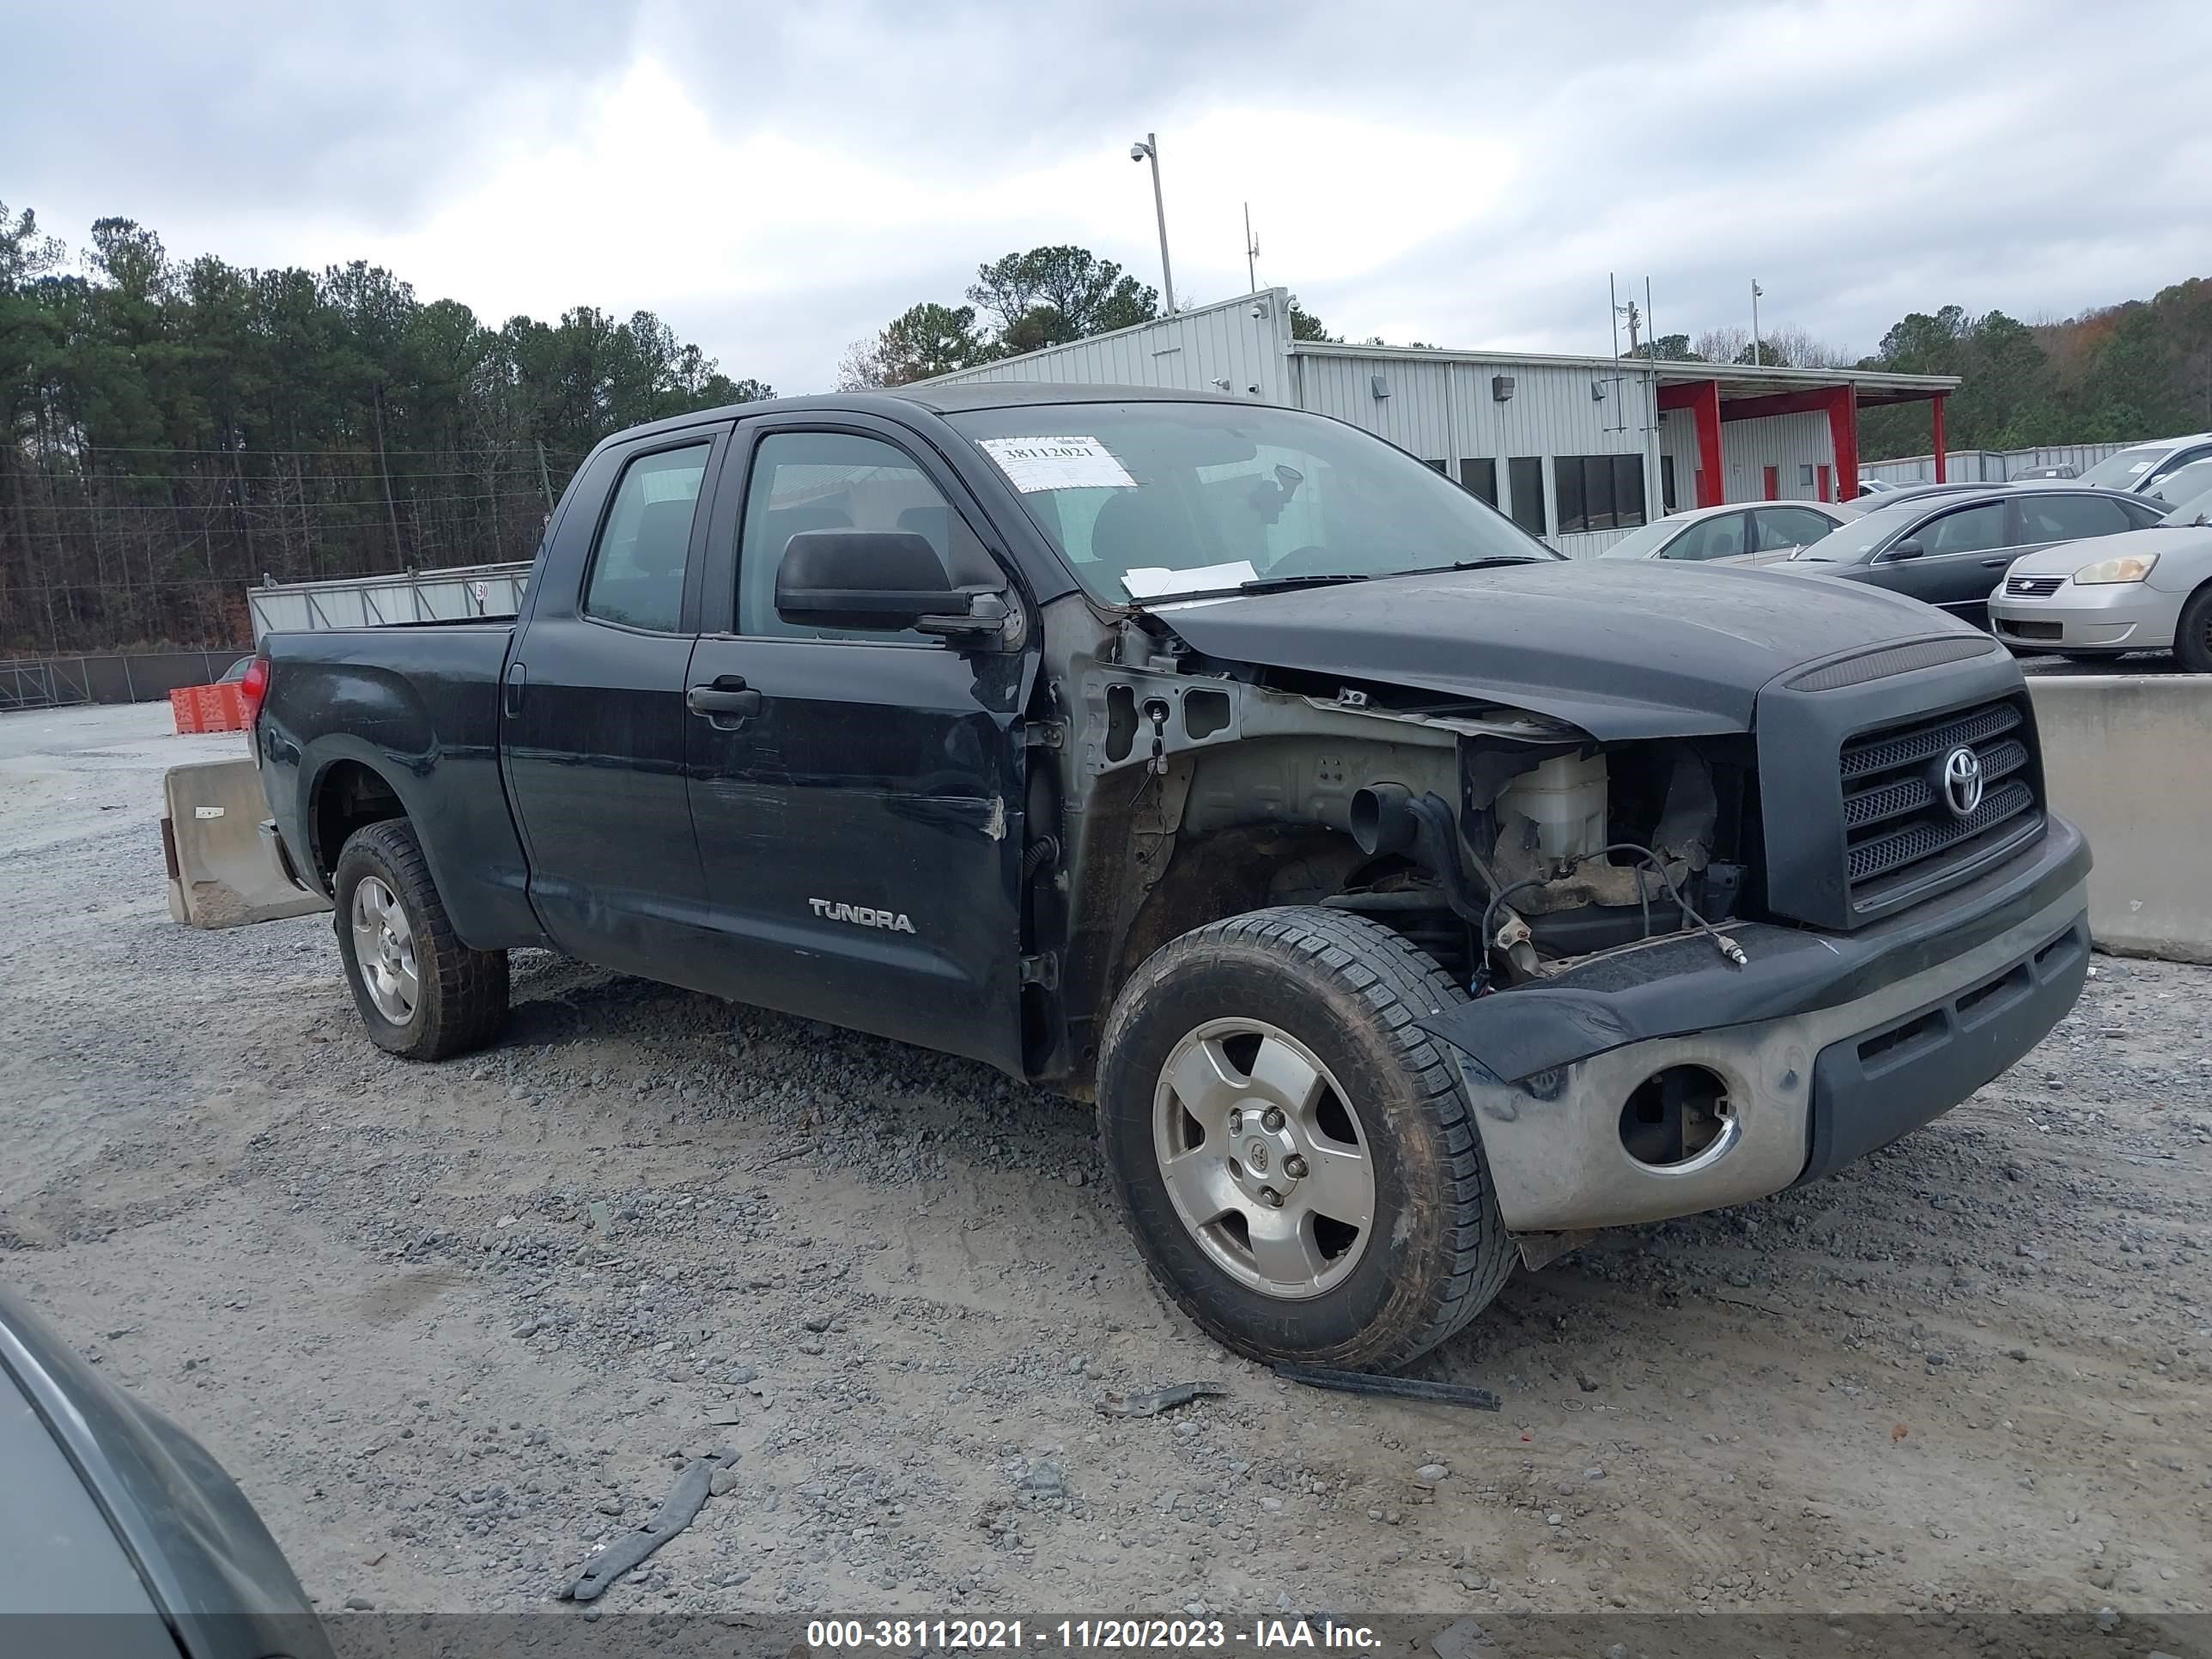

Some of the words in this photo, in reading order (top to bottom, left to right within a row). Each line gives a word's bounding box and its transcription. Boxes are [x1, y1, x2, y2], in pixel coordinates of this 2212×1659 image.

[1002, 447, 1094, 460] 38112021
[477, 584, 489, 598] 30
[808, 897, 917, 934] TUNDRA
